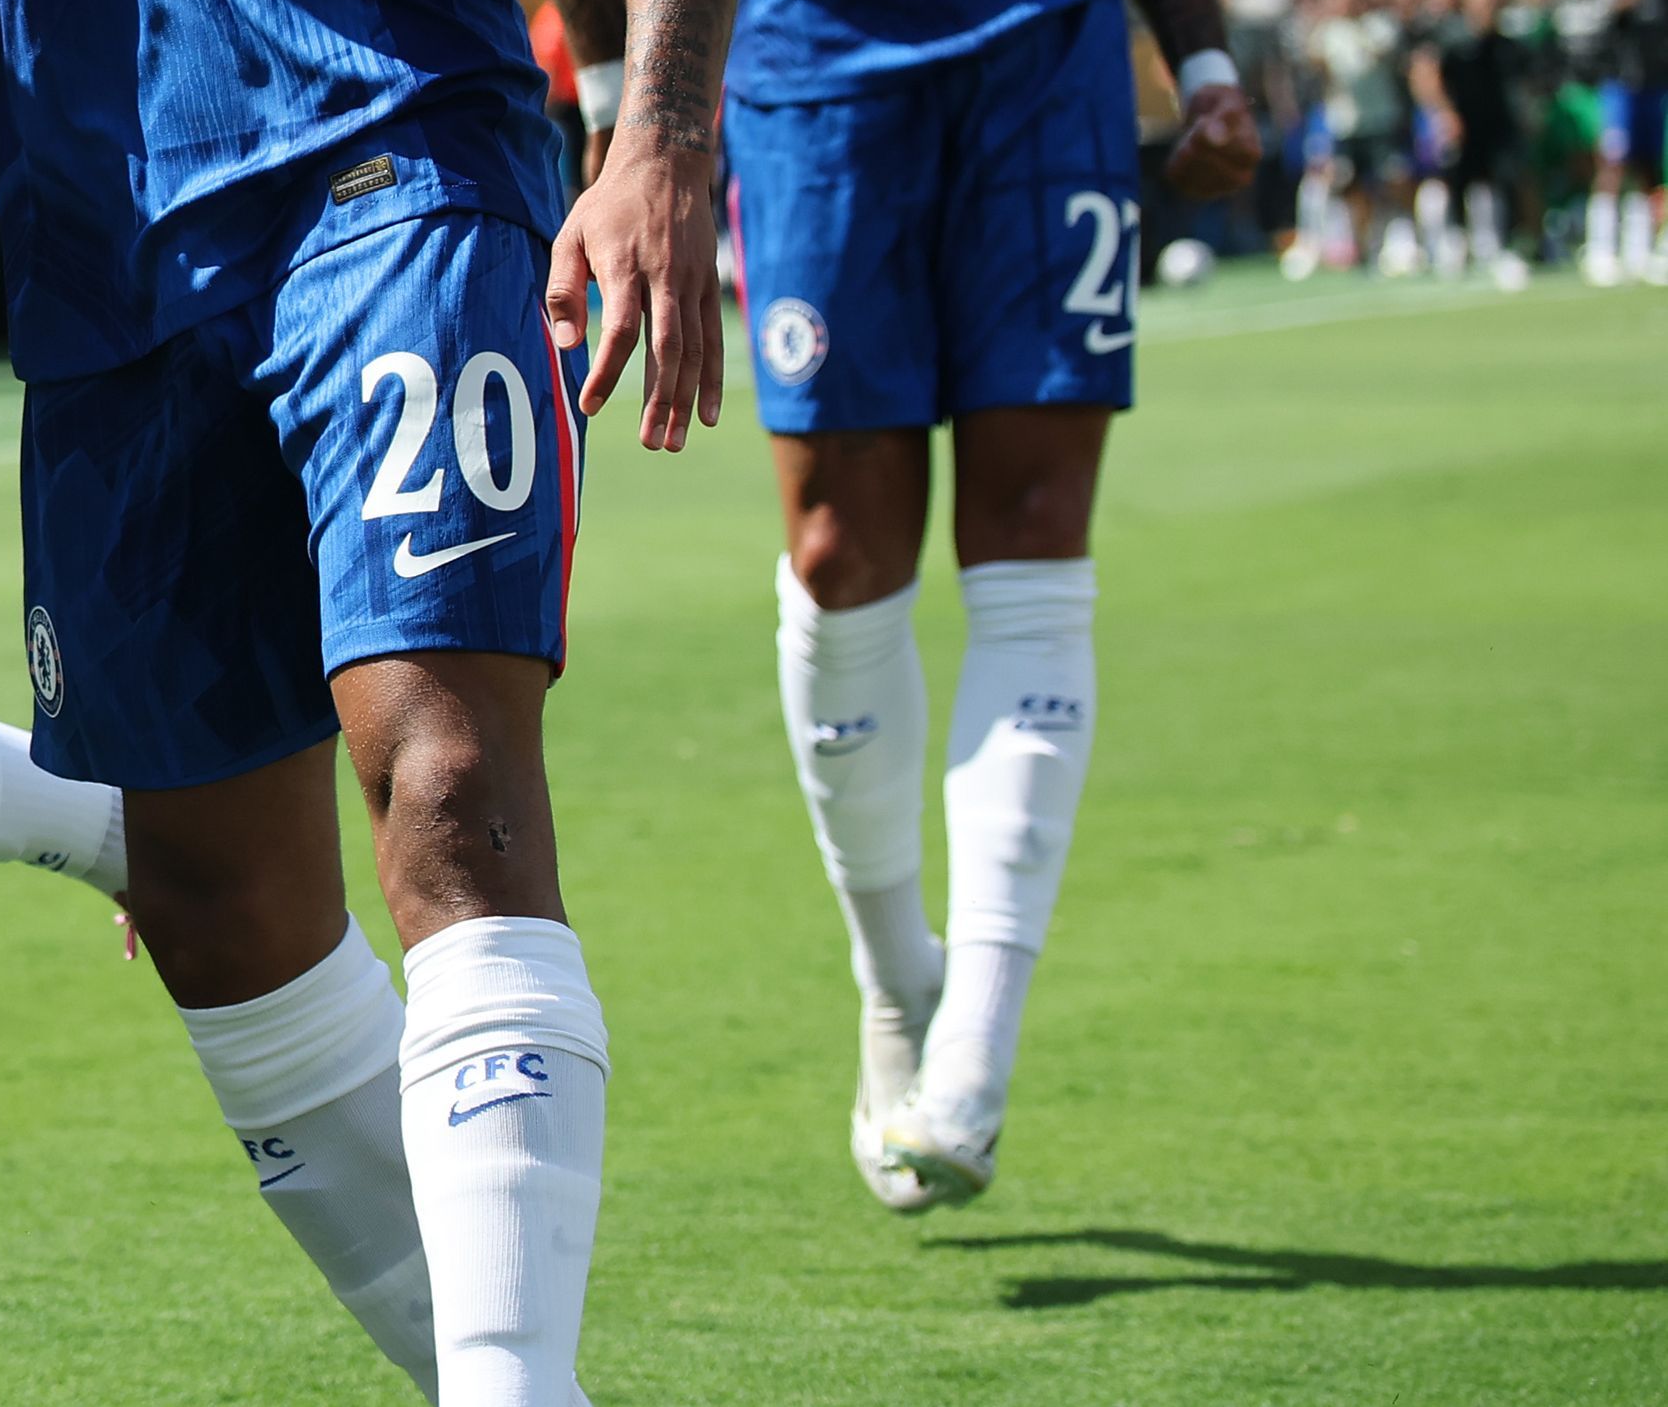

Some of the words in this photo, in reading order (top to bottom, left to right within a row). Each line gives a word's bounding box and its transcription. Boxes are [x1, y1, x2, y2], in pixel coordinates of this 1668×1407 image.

[360, 351, 536, 521] 20
[455, 1052, 548, 1091] CFC
[241, 1137, 296, 1162] FC
